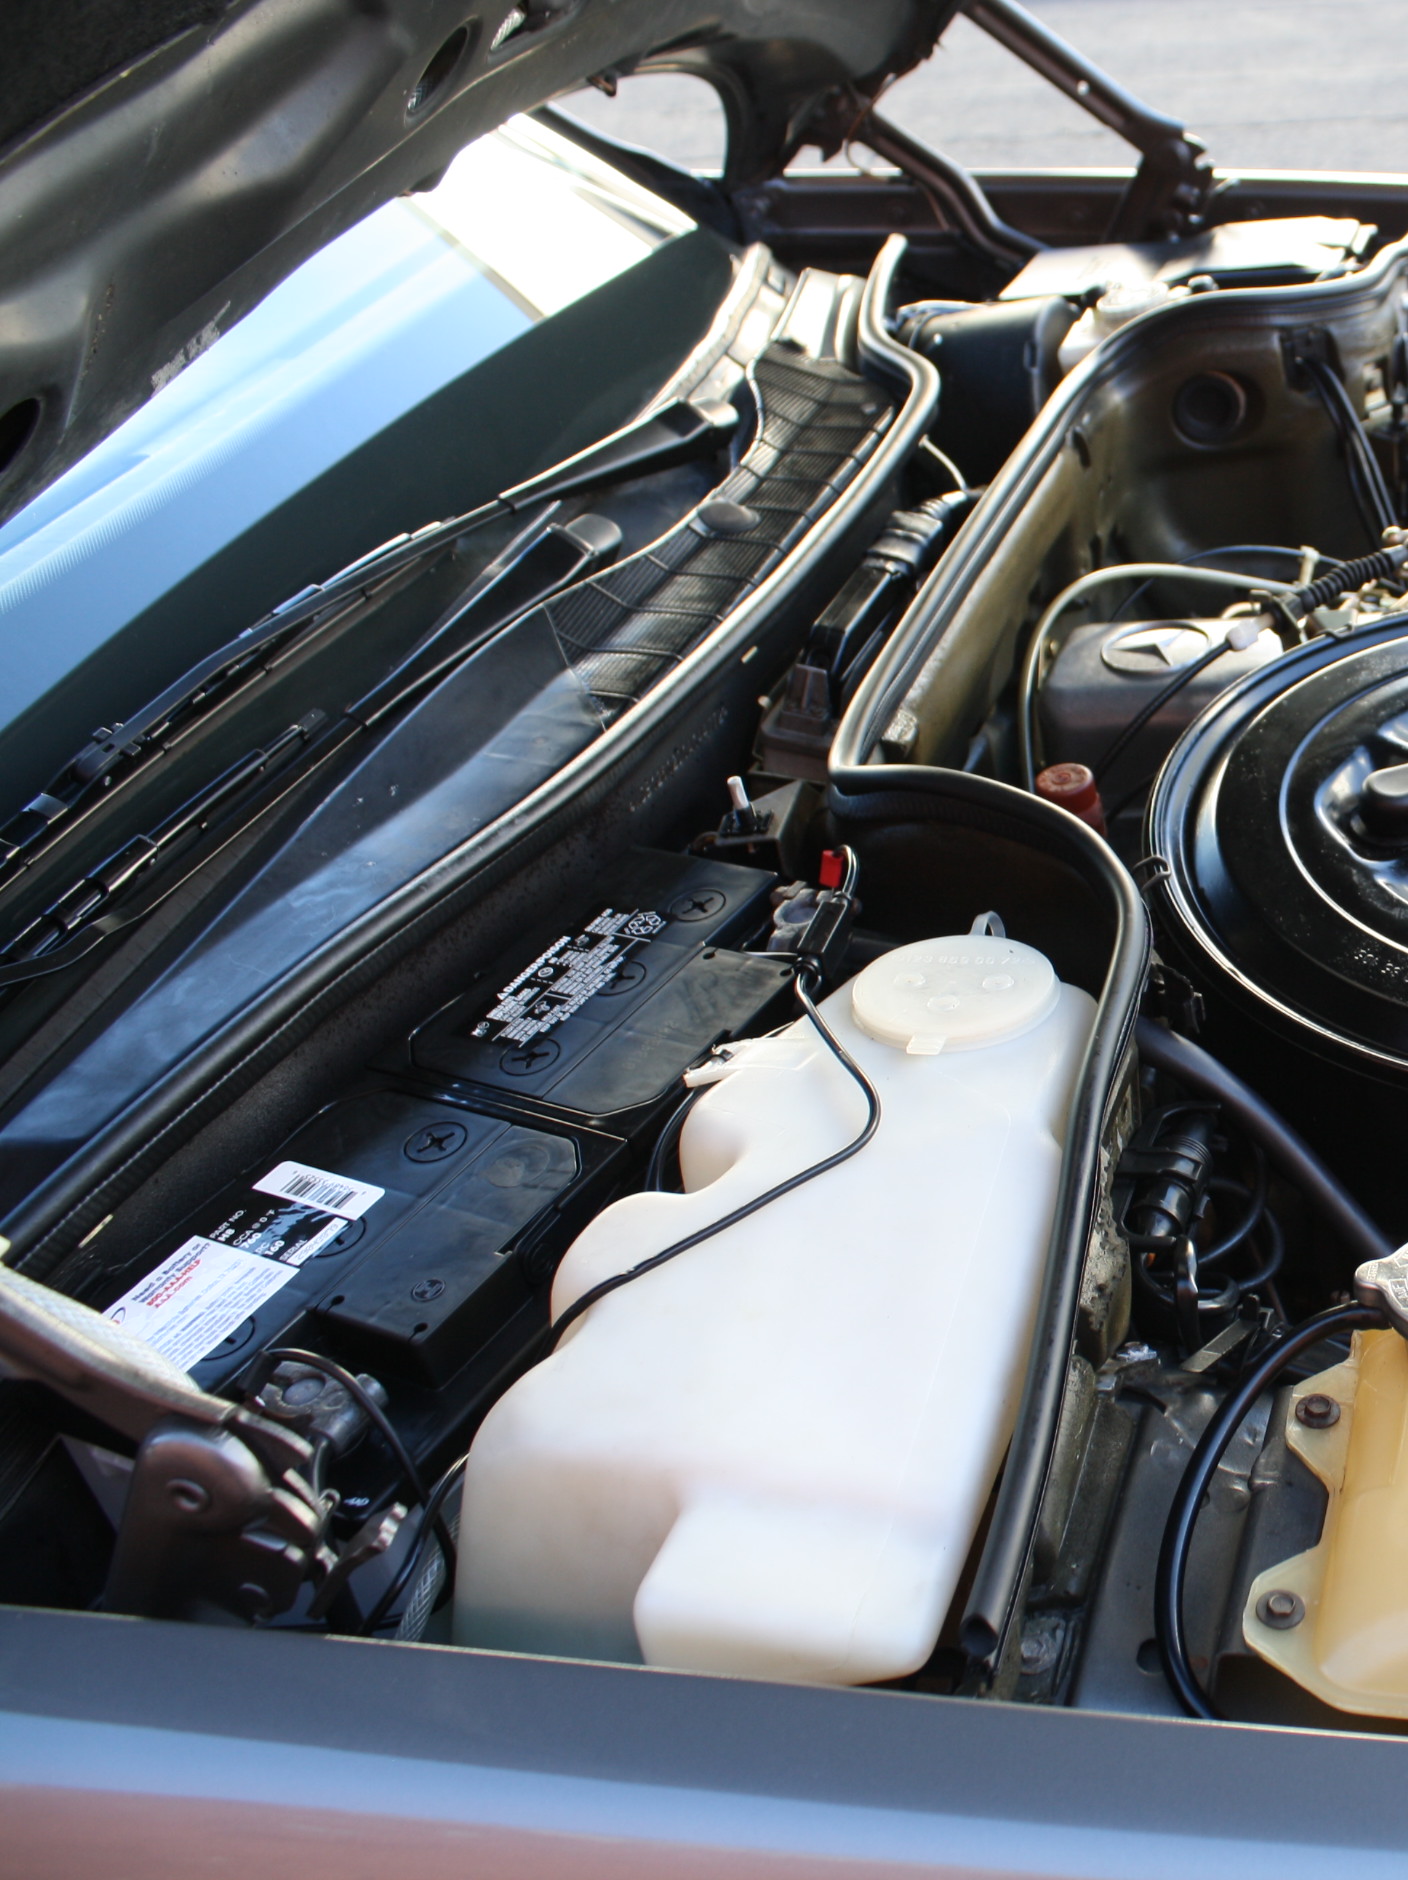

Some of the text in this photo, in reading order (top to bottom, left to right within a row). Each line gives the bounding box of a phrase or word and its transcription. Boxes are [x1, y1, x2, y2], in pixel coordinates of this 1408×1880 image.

[233, 1229, 255, 1246] CCA
[240, 1231, 262, 1249] 760
[264, 1240, 285, 1256] 160
[279, 1238, 308, 1261] SERIAL
[131, 1282, 156, 1301] Need
[162, 1252, 192, 1275] Battery
[138, 1242, 211, 1303] Warranty Support?
[146, 1259, 202, 1306] 800-AAA-HELP
[154, 1276, 193, 1309] AAA.com
